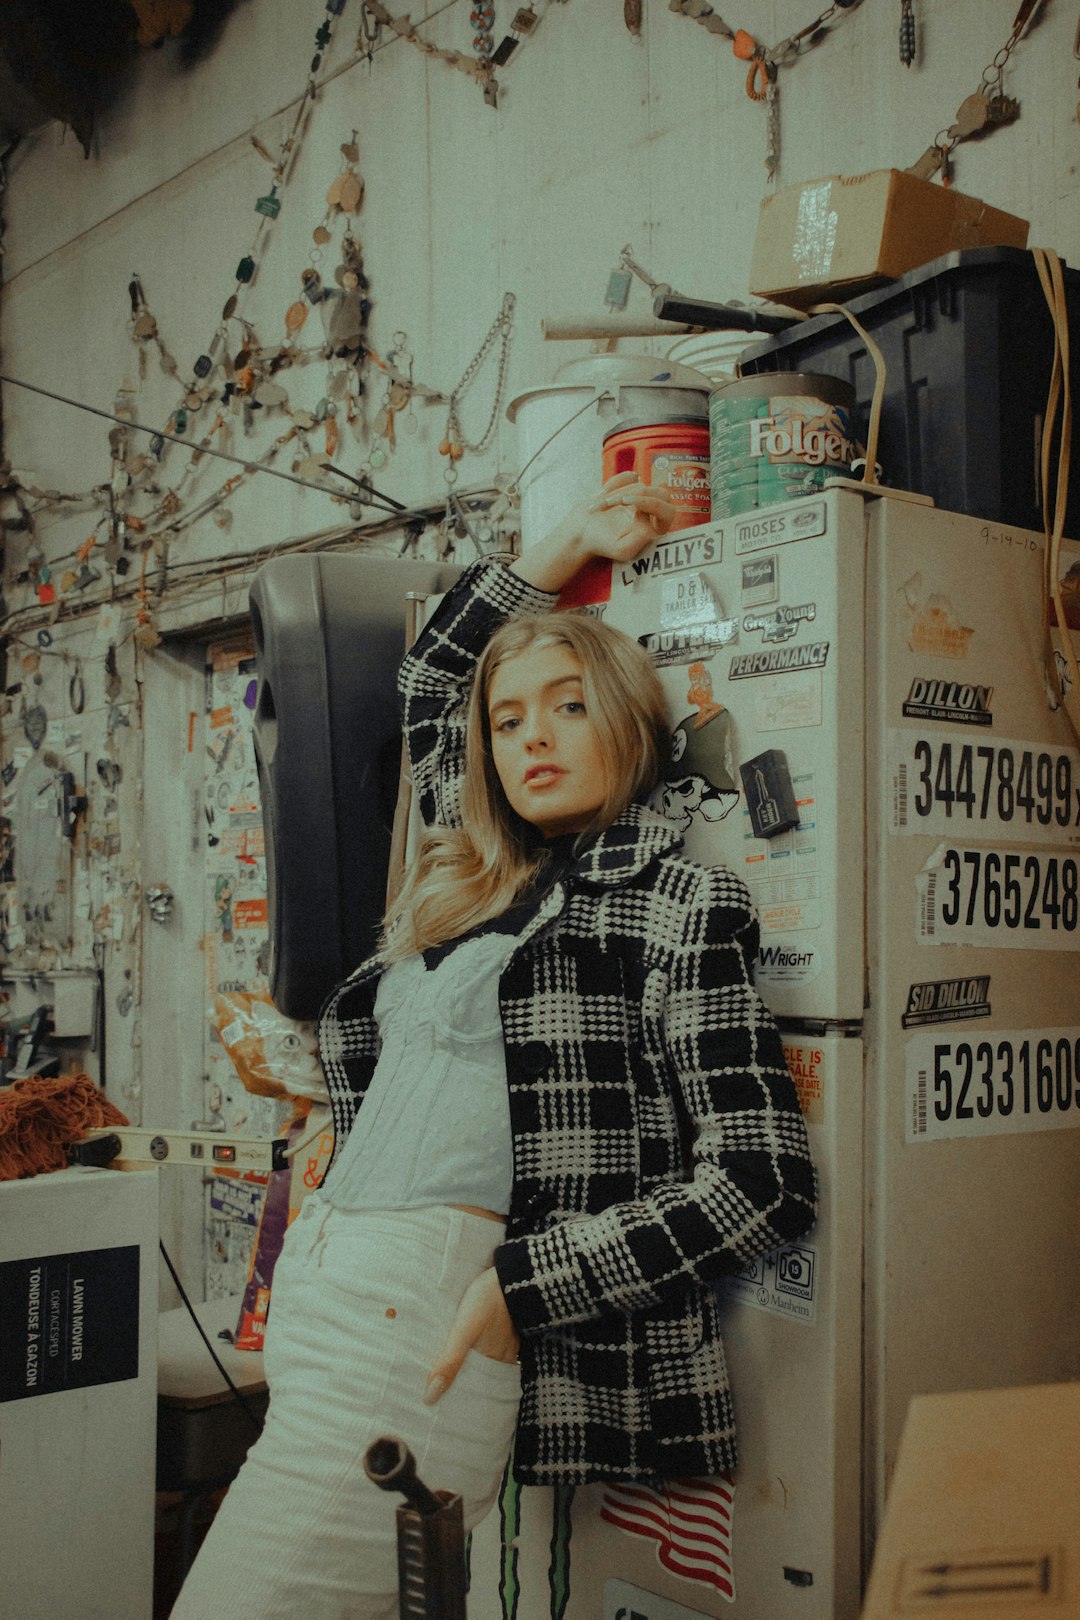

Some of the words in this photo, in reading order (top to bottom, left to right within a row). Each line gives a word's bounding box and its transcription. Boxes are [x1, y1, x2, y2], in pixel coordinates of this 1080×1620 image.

[667, 470, 711, 491] Folgers
[740, 517, 785, 541] MOSES
[741, 537, 768, 549] MOTOR
[632, 537, 715, 576] WALLY'S
[665, 598, 697, 613] TRAILER
[777, 603, 816, 622] Young
[731, 642, 829, 675] PERFORMANCE
[908, 678, 994, 711] DILLON
[942, 849, 1078, 932] 3765248
[759, 945, 814, 967] WRIGHT
[910, 985, 936, 1012] SID
[937, 979, 988, 1009] DILLON
[811, 1050, 821, 1064] IS
[28, 1266, 41, 1331] TONDEUSE
[73, 1278, 85, 1315] LAWN
[778, 1282, 810, 1296] SHOWROOM
[771, 1294, 809, 1317] Manheim
[72, 1316, 84, 1361] MOWER
[26, 1344, 39, 1387] GAZON
